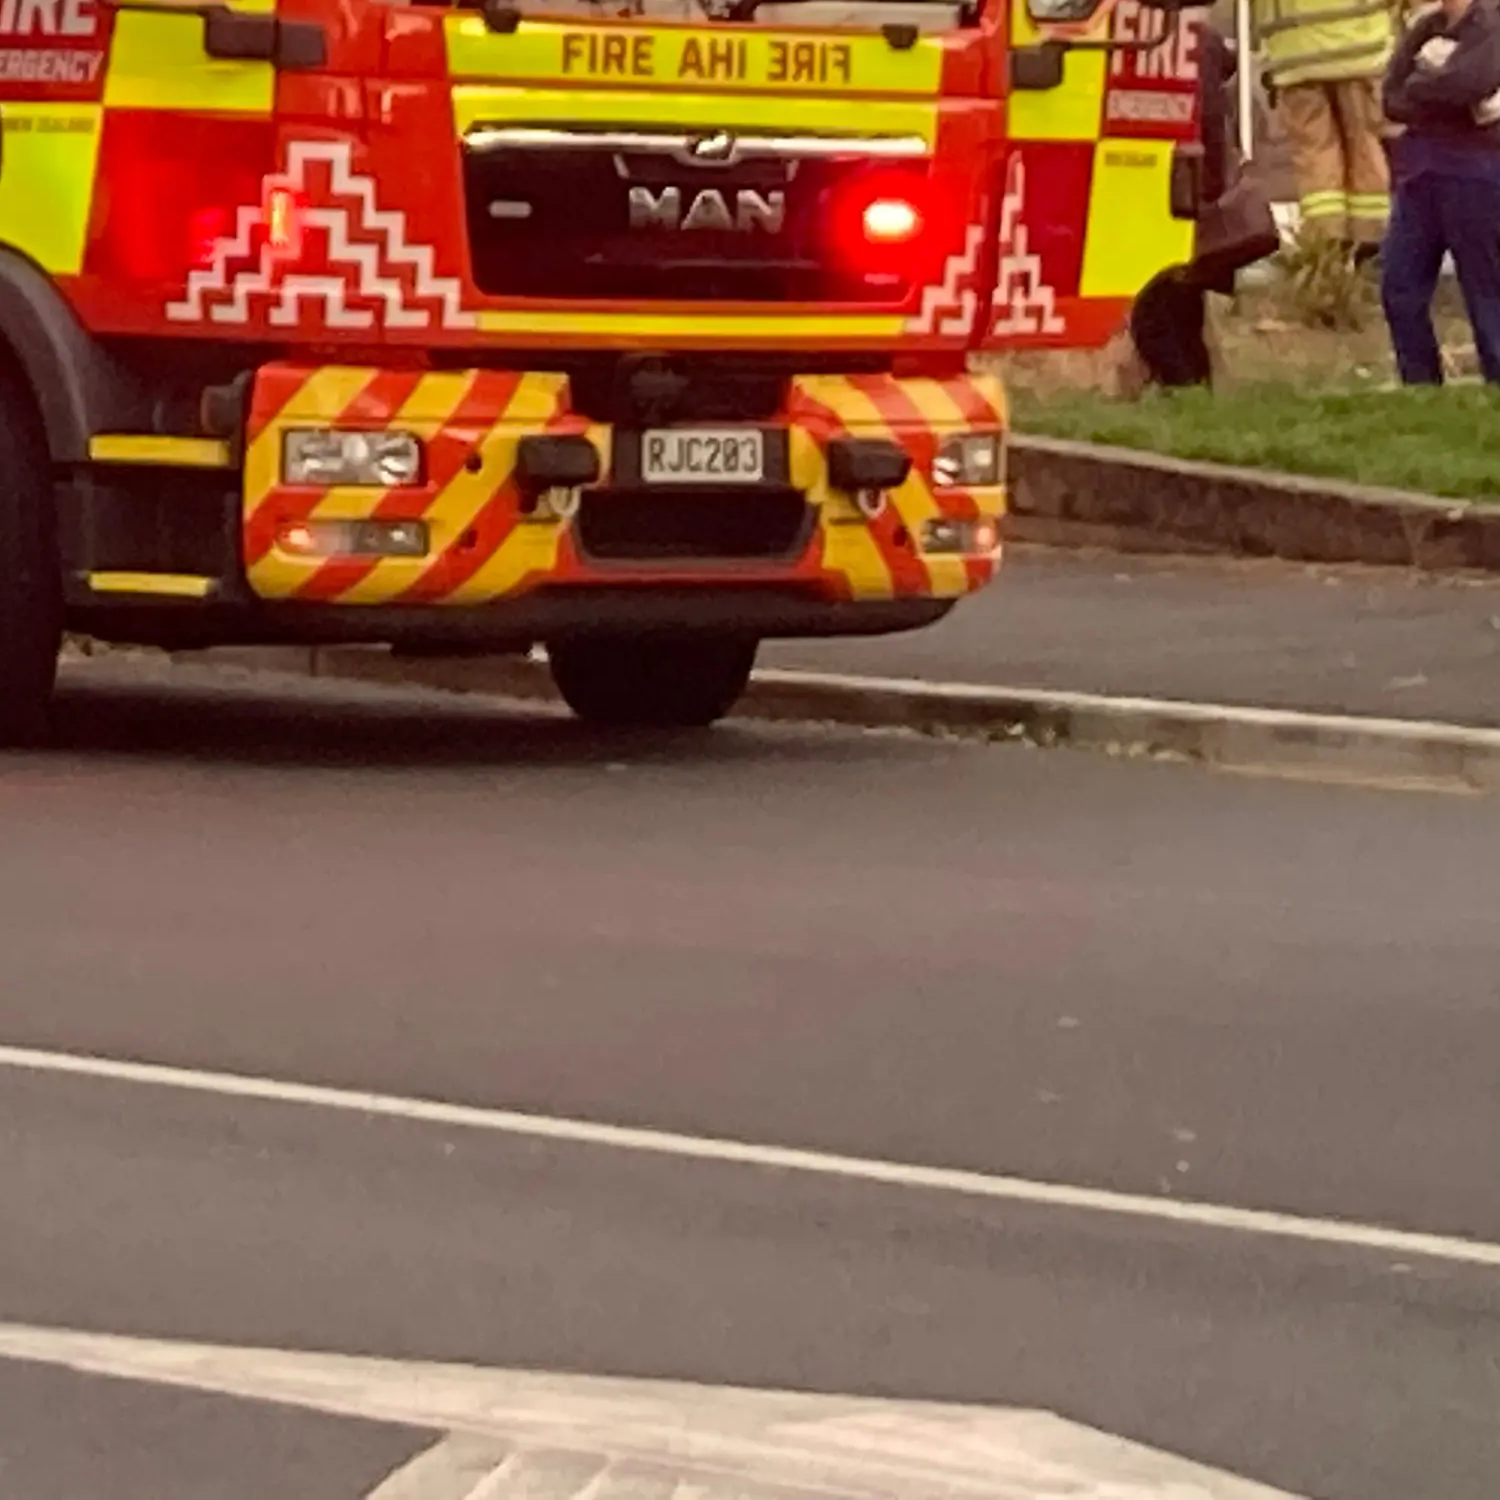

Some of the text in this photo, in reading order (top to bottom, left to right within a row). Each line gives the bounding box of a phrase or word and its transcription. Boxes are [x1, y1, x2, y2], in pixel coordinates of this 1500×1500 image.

[561, 33, 655, 75] FIRE
[677, 37, 747, 80] AHI
[1112, 0, 1203, 80] FIRE
[628, 186, 785, 233] MAN
